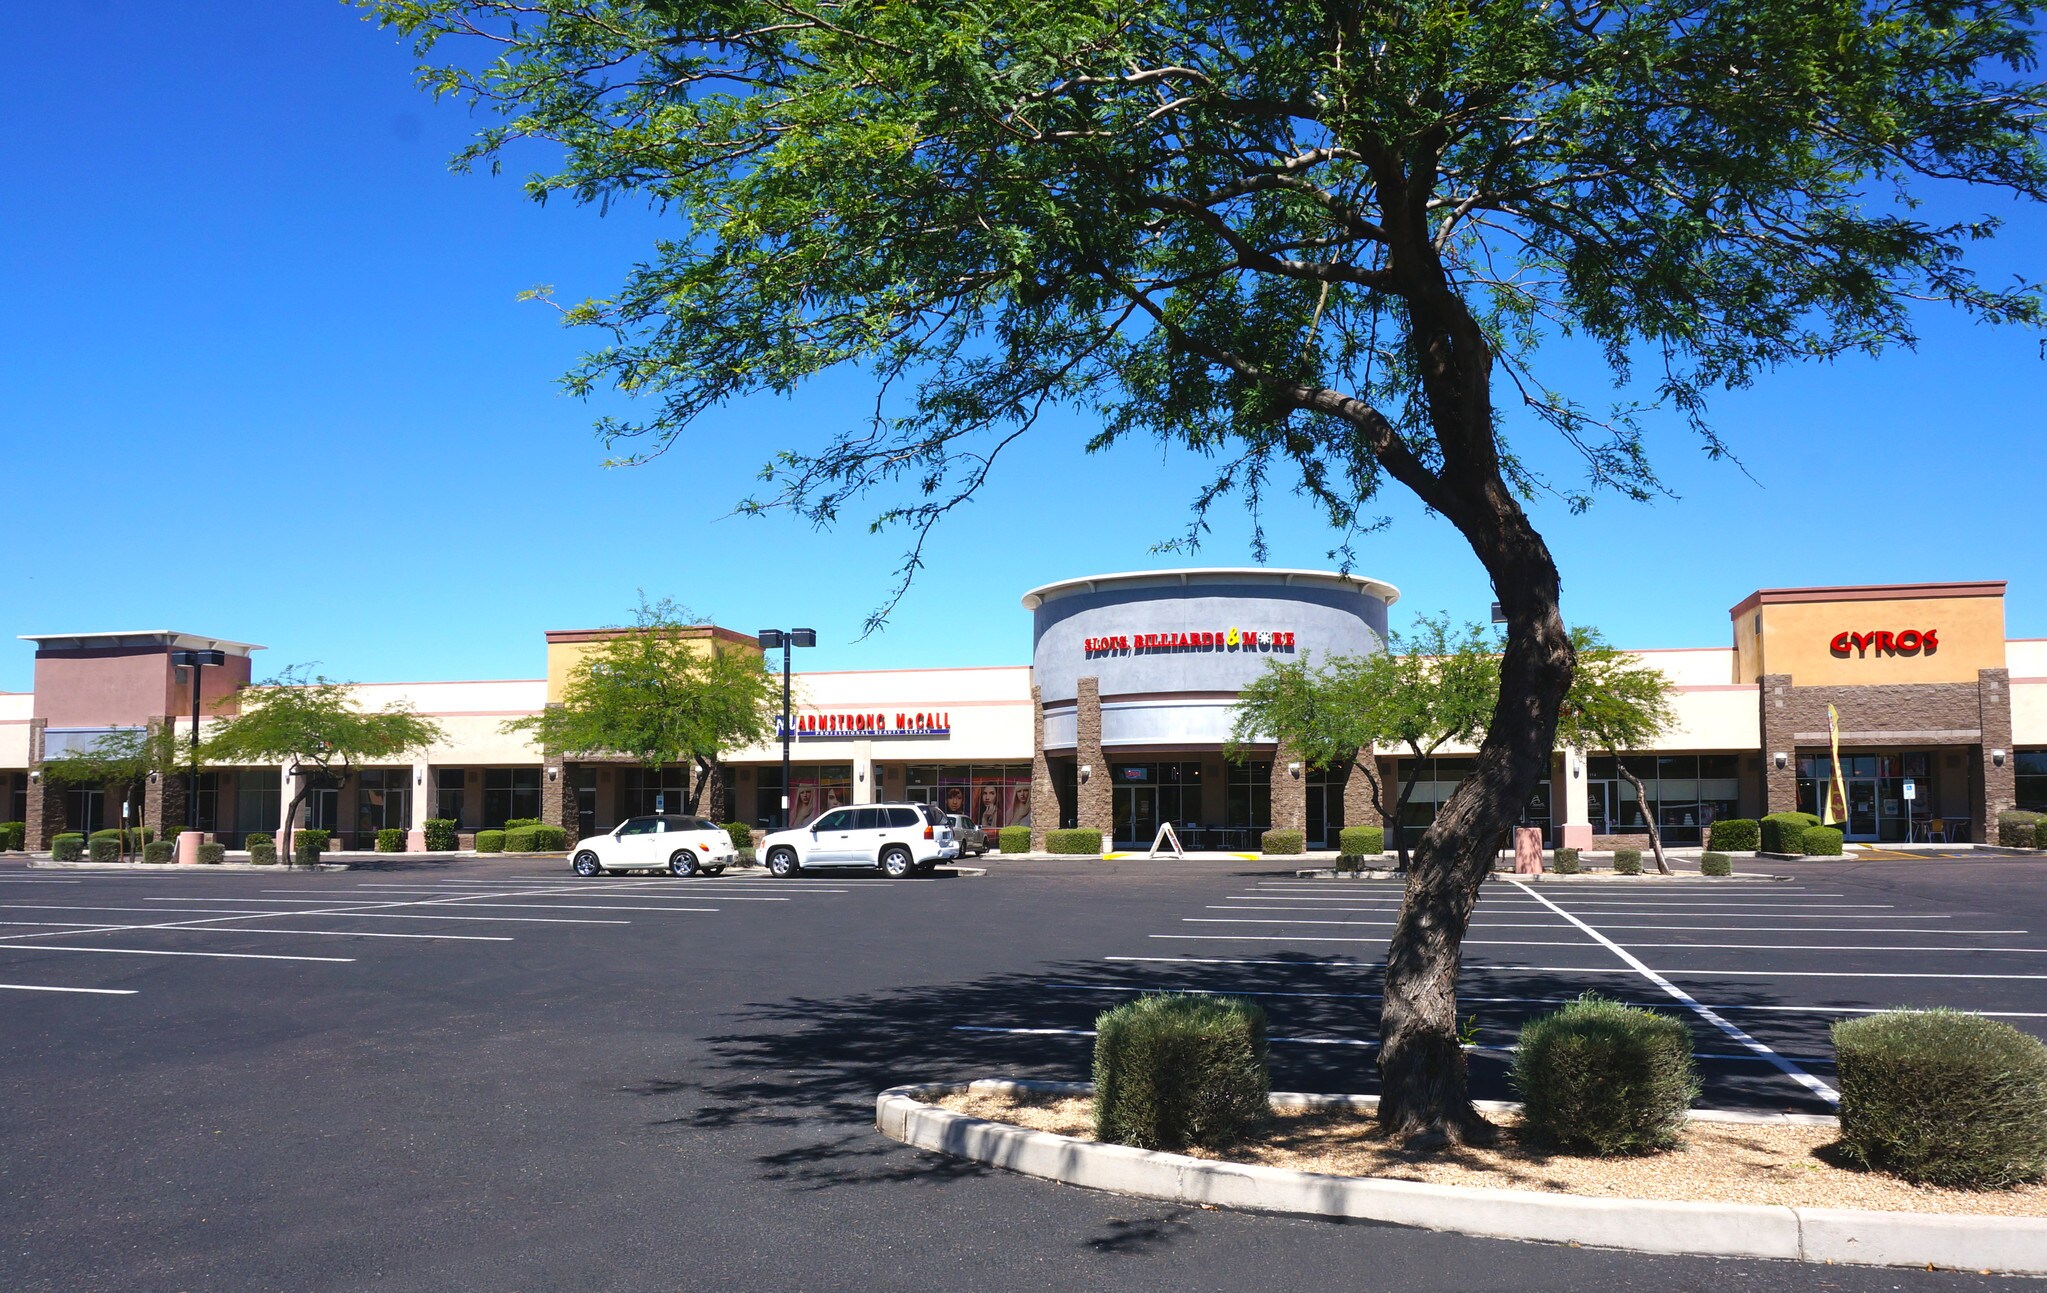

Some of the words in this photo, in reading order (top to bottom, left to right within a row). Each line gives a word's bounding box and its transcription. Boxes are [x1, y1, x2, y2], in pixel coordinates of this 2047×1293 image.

[1084, 635, 1132, 651] SLOTS,
[1134, 631, 1225, 648] BILLIARDS
[1226, 627, 1240, 646] &
[1830, 629, 1939, 652] GYROS
[798, 713, 885, 731] ARMSTRONG
[896, 712, 951, 730] McCALL
